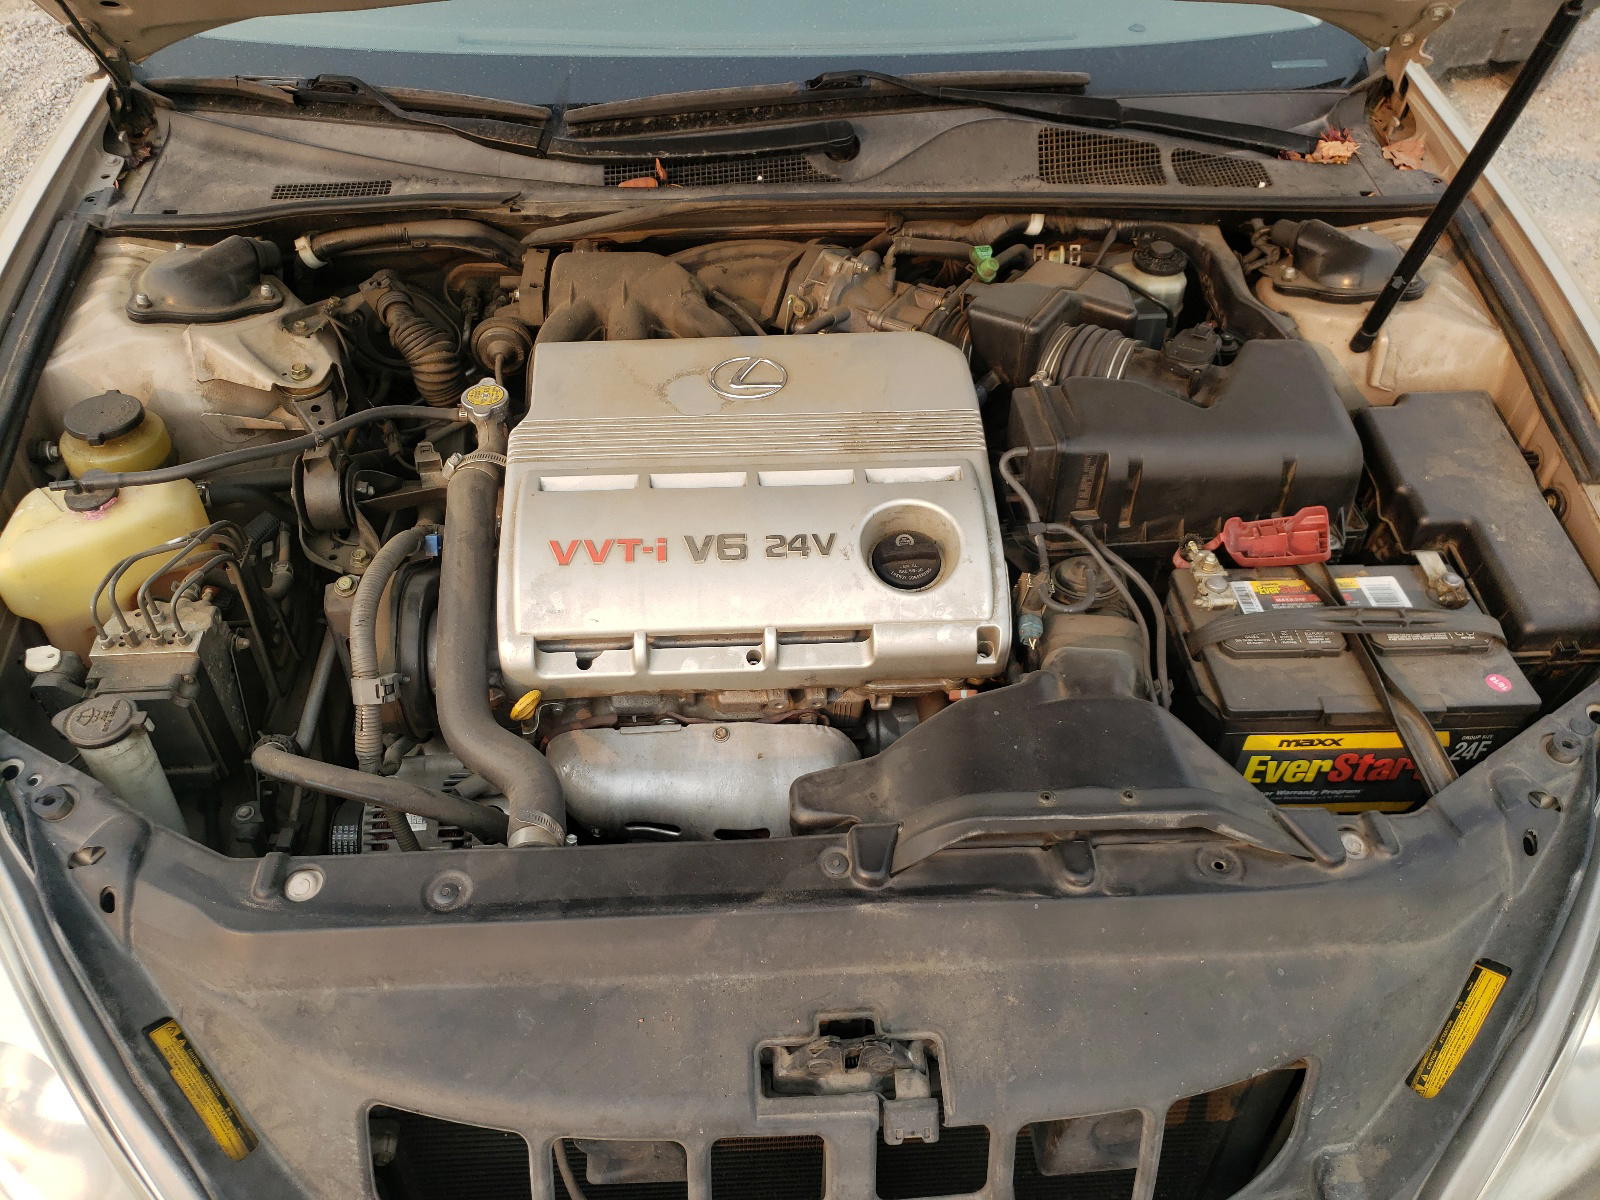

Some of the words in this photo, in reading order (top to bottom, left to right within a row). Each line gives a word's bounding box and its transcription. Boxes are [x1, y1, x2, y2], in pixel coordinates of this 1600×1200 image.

[548, 537, 667, 566] VVT-i
[683, 533, 749, 564] V6
[765, 532, 837, 560] 24V
[1278, 738, 1344, 747] maxx
[1450, 741, 1492, 761] 24F
